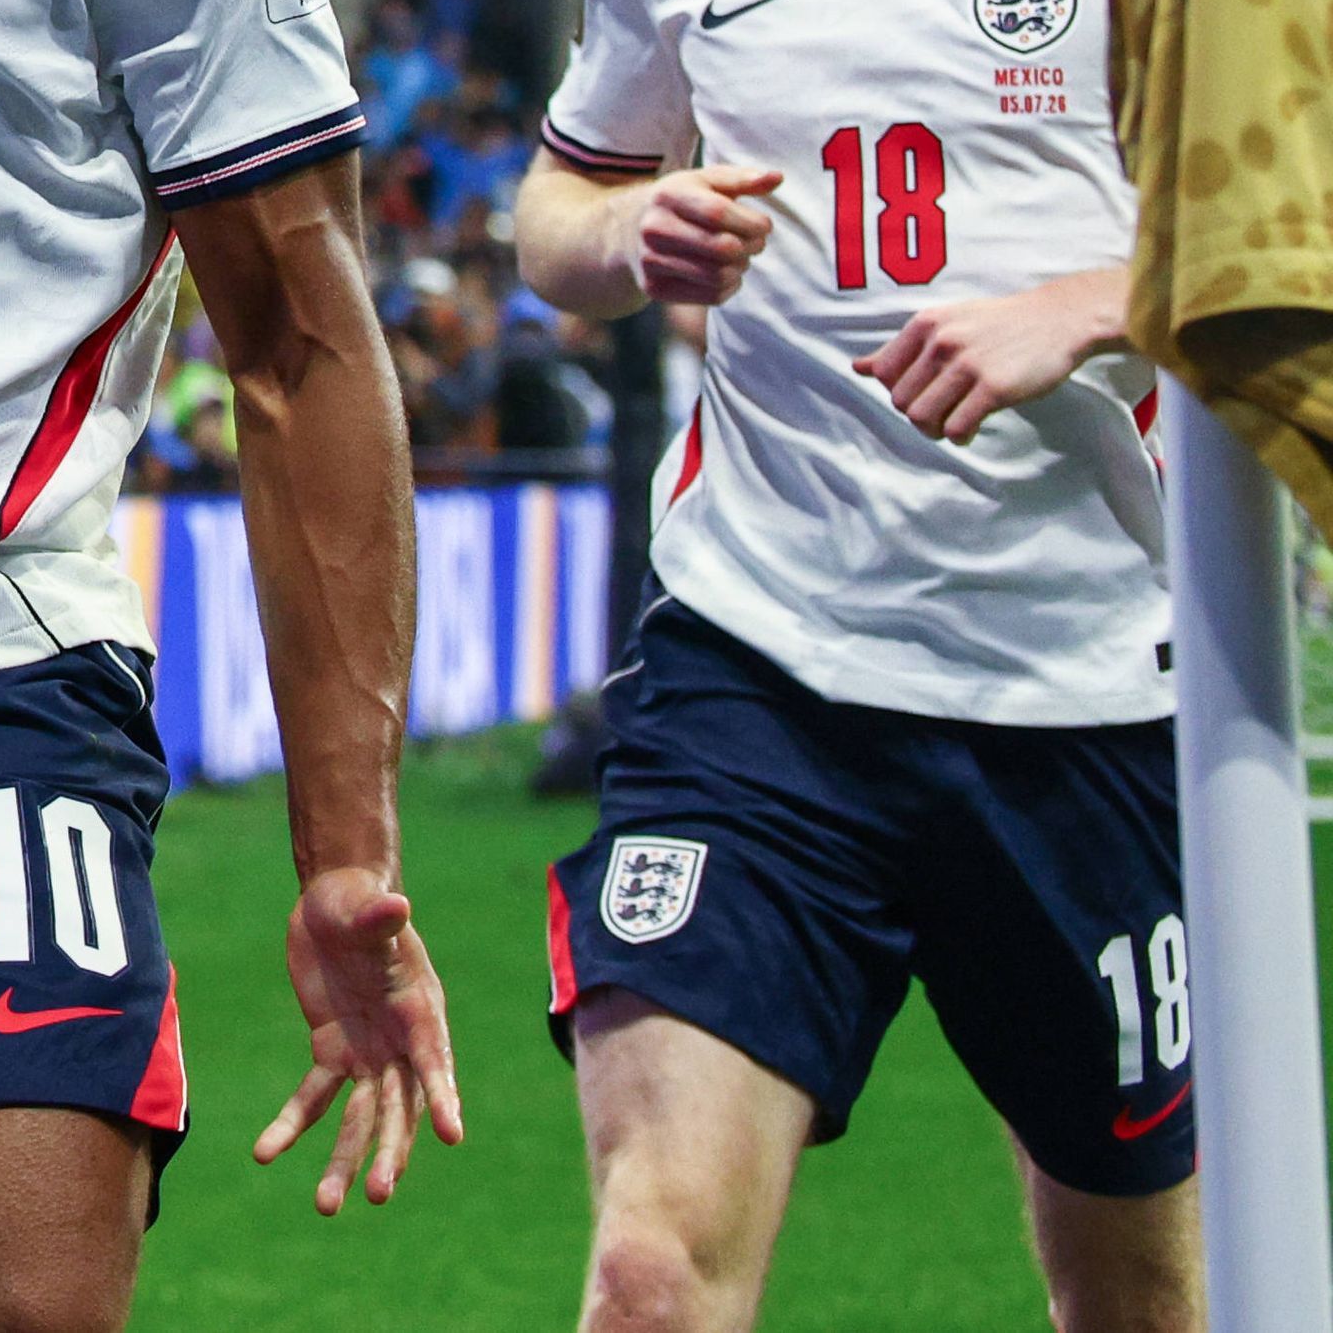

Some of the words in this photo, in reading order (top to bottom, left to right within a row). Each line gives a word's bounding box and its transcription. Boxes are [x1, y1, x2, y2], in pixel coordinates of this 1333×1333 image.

[994, 67, 1064, 86] MEXICO
[1000, 95, 1067, 114] 05.07.26
[822, 122, 947, 290] 18
[1097, 912, 1191, 1086] 18
